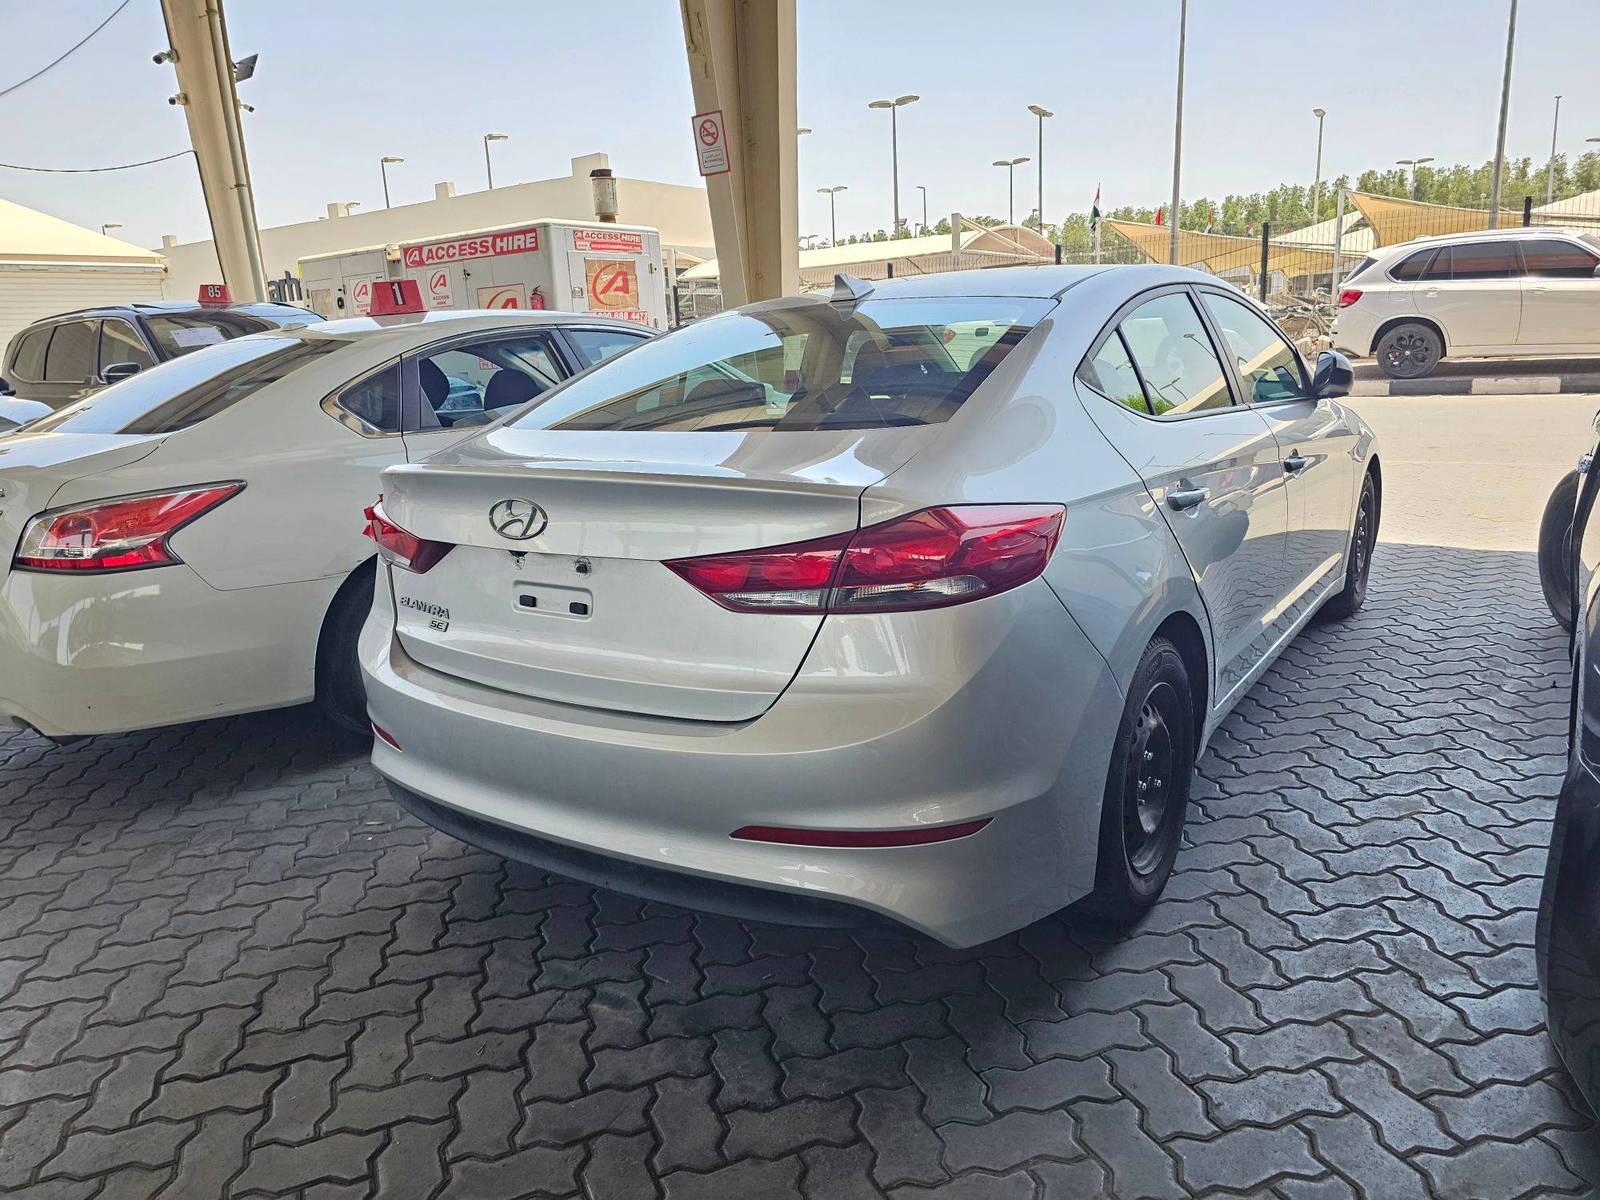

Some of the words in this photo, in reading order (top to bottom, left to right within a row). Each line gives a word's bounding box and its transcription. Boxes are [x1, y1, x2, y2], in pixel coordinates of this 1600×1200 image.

[584, 232, 620, 241] ACCESS
[621, 233, 641, 243] HIRE
[425, 240, 491, 262] ACCESS
[495, 233, 537, 252] HIRE
[207, 285, 221, 298] 85
[392, 282, 404, 305] 1
[631, 311, 649, 321] 4473
[401, 596, 450, 620] ELANTRA
[430, 620, 445, 630] SE
